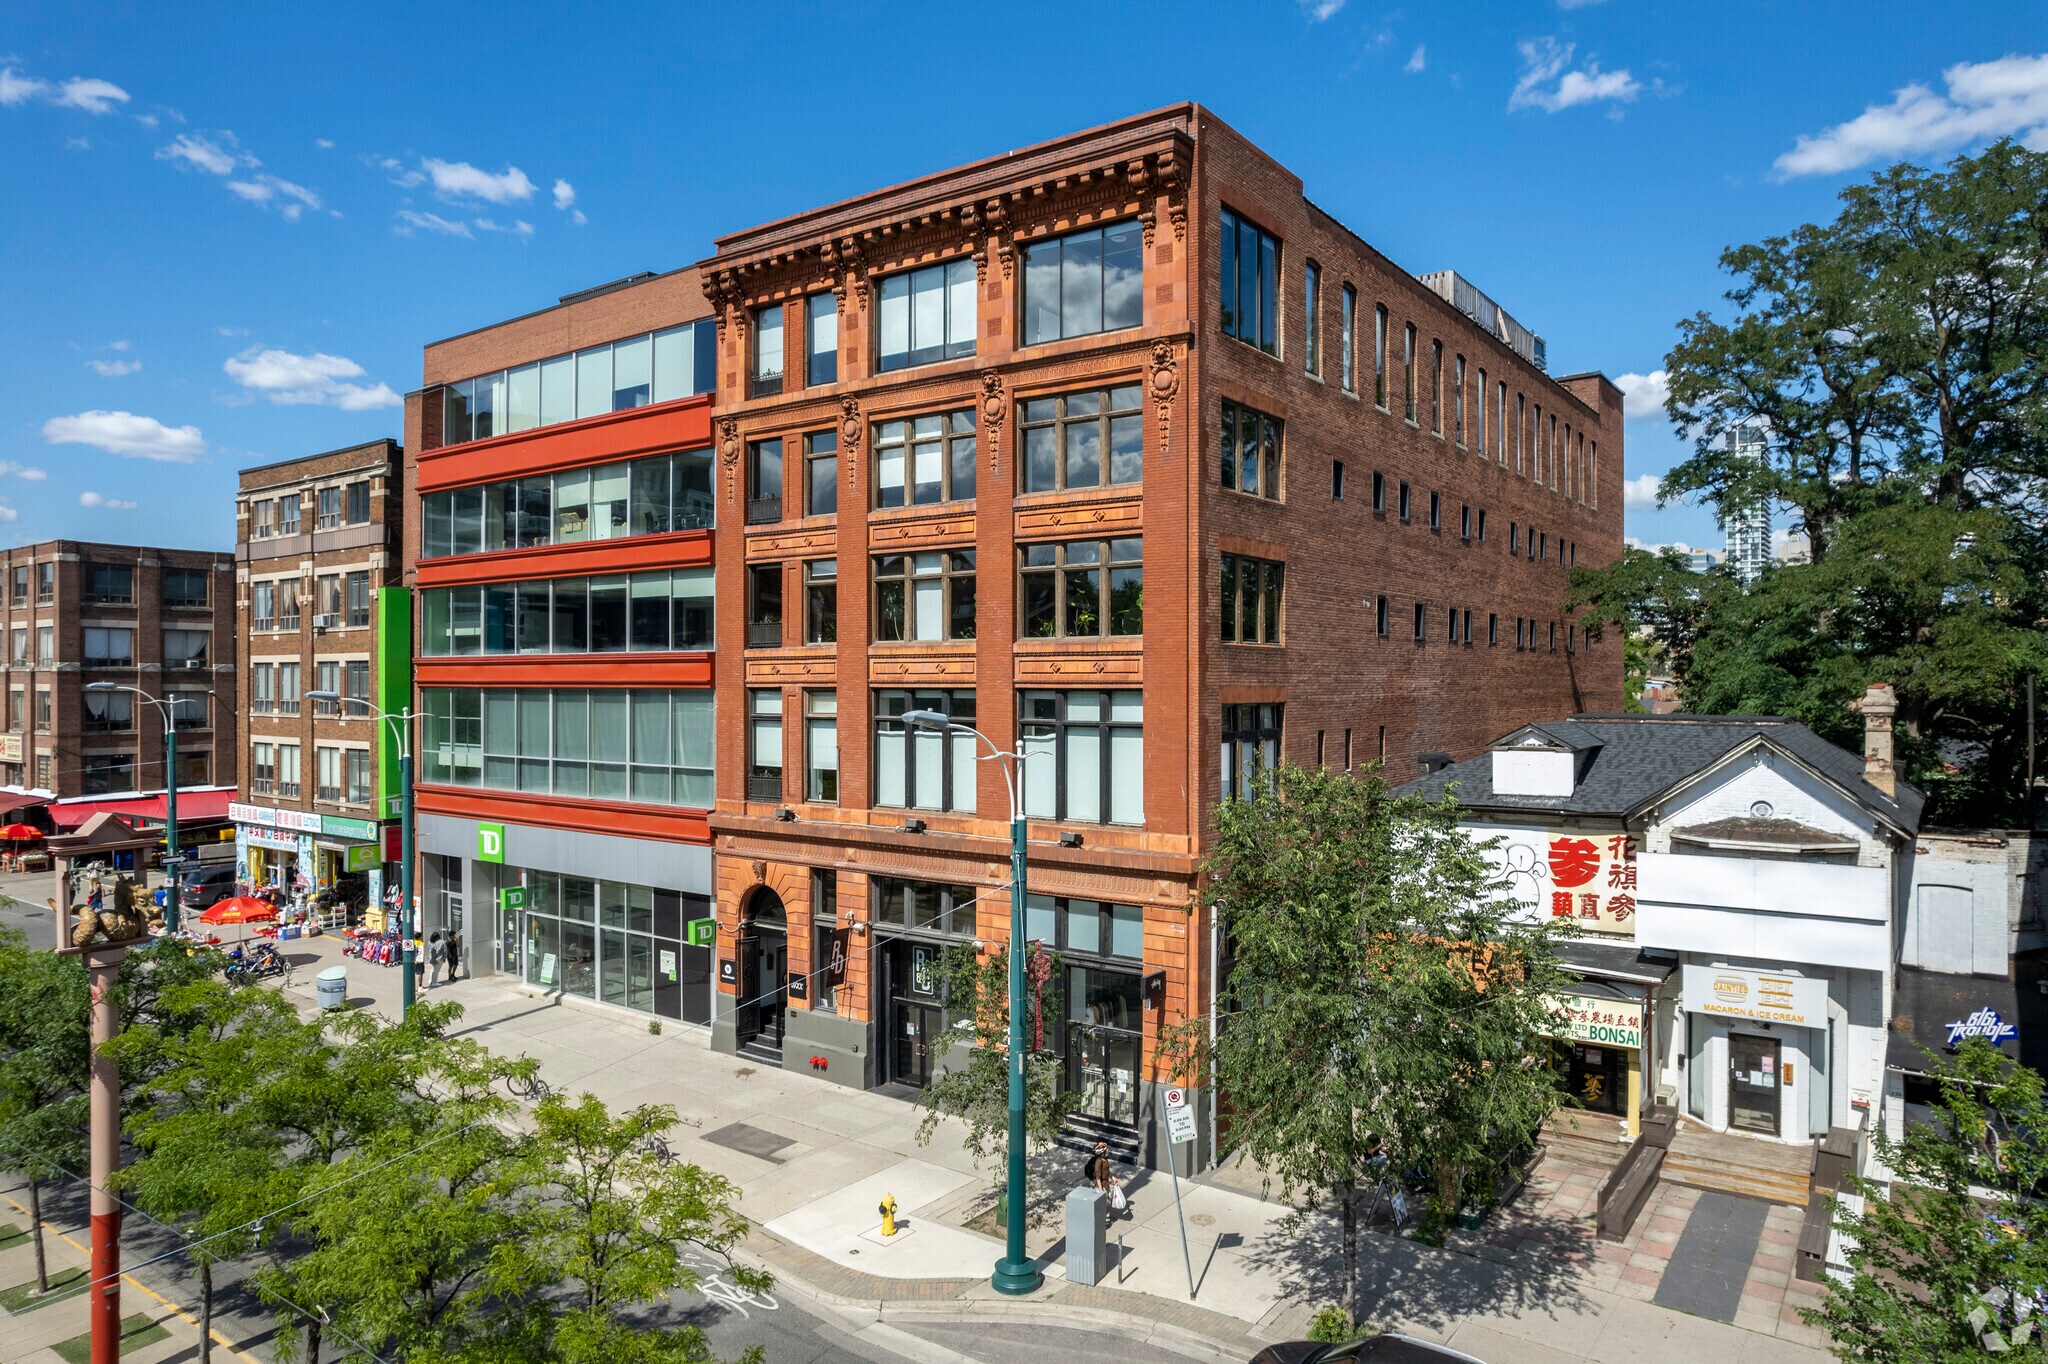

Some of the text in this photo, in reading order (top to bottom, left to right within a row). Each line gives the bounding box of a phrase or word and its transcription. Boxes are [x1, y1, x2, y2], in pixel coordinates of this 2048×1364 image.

[480, 829, 500, 855] TD
[507, 892, 523, 905] TD
[697, 925, 712, 940] TD
[1713, 982, 1749, 994] DAINTIES
[1703, 1003, 1805, 1023] MACARON & ICE CREAM
[1966, 1006, 1997, 1027] BIG
[1575, 1024, 1588, 1032] LTD
[1589, 1025, 1640, 1047] BONSAI
